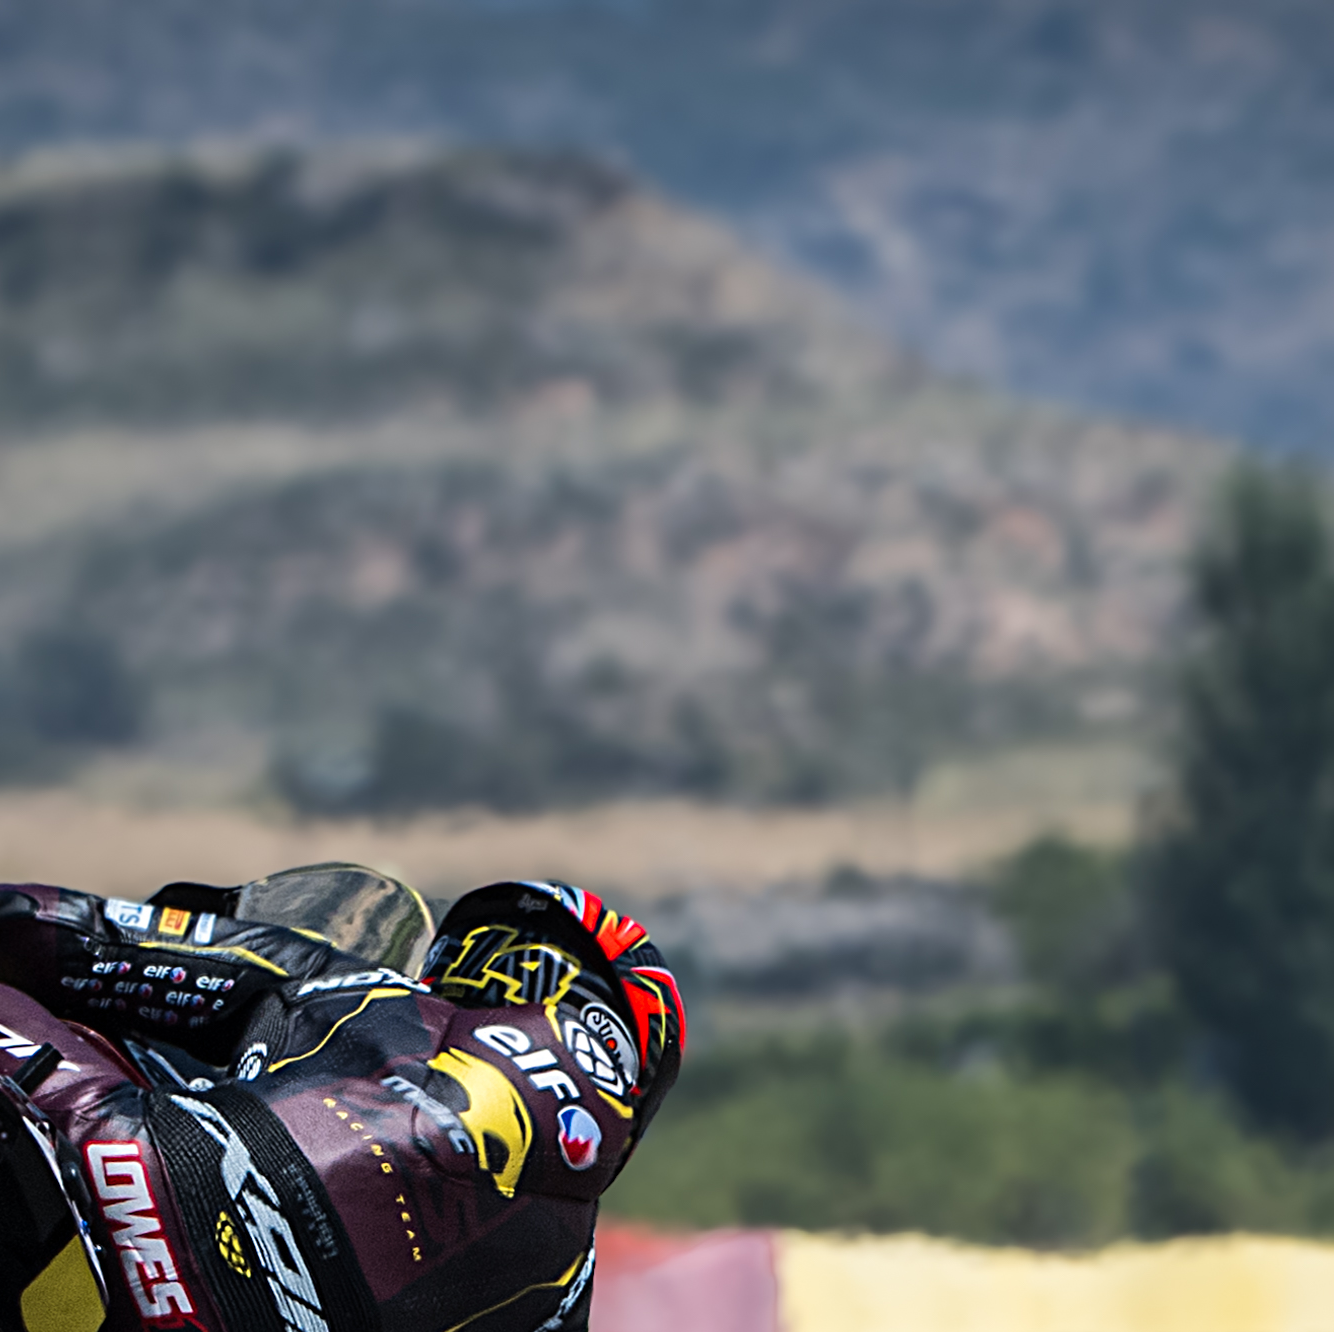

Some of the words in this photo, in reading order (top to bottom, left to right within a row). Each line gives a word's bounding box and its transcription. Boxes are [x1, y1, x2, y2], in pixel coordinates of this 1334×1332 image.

[91, 961, 119, 975] elf
[142, 965, 173, 980] elf
[113, 981, 140, 995] elf
[195, 975, 225, 993] elf
[164, 990, 192, 1007] elf
[471, 1022, 581, 1103] elf
[322, 1097, 393, 1175] RACING
[394, 1193, 423, 1262] TEAM
[81, 1138, 196, 1320] LOWES
